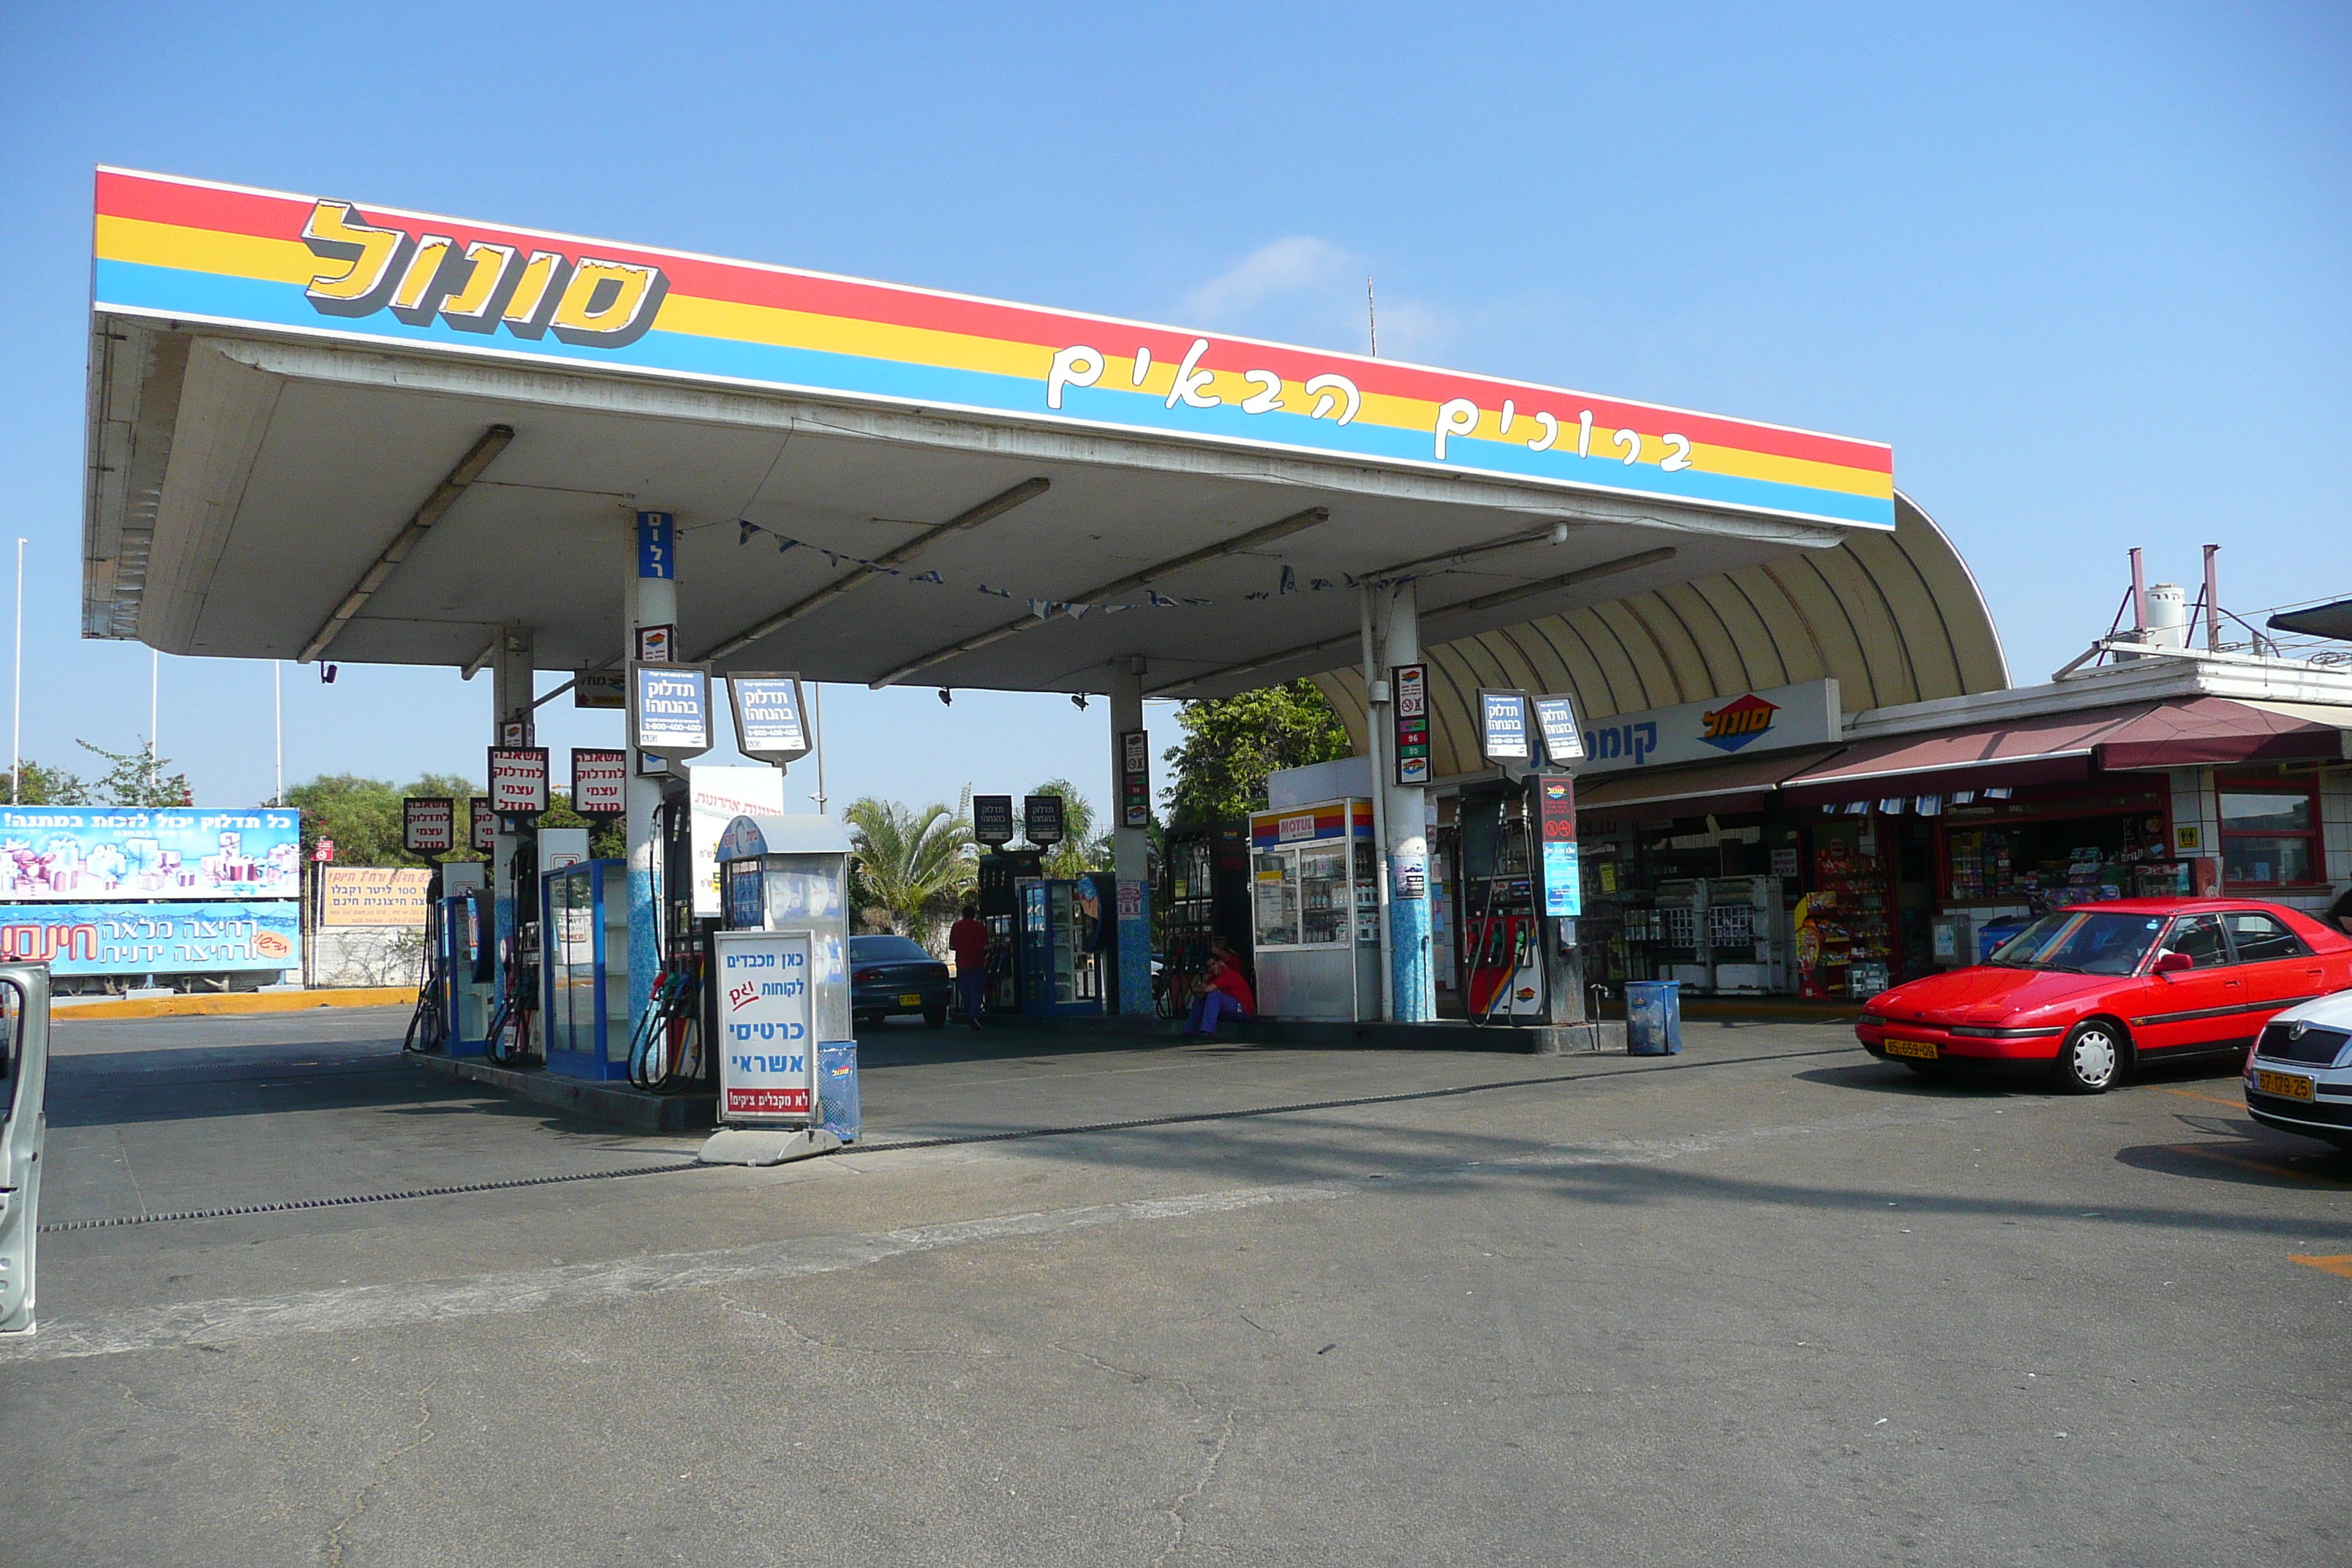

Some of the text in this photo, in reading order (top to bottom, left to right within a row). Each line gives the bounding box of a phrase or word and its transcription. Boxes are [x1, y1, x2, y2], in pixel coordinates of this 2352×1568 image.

[301, 199, 671, 349] סונול
[1047, 339, 1692, 472] ברוכים הבאים
[647, 513, 663, 577] סולר
[647, 679, 695, 698] תדלוק
[745, 689, 788, 707] תדלוק
[645, 698, 698, 714] בהנחה!
[1488, 704, 1518, 719] תדלוק
[745, 707, 794, 720] בהנחה!
[1542, 709, 1568, 724] תדלוק
[1488, 720, 1521, 731] בהנחה!
[1703, 706, 1773, 739] סונול
[494, 751, 544, 761] משאבה
[576, 753, 625, 762] משאבה
[493, 766, 544, 779] לתדלוק
[577, 769, 625, 782] לתדלוק
[502, 784, 535, 796] עצמי
[587, 786, 617, 796] עצמי
[499, 799, 536, 810] מוזל
[585, 801, 621, 811] מוזל
[694, 792, 740, 812] אחרונות
[982, 804, 1004, 815] תדלוק
[1032, 804, 1054, 815] תדלוק
[4, 813, 291, 832] כל תדלוק יכול לזכות במתנה!
[409, 813, 450, 824] לתדלוק
[1280, 818, 1313, 834] MOTUL
[414, 840, 445, 848] מוזל
[331, 884, 361, 897] וקבלו
[366, 884, 393, 894] ליטר
[333, 897, 359, 906] חינם
[363, 898, 407, 906] חיצונית
[102, 918, 258, 939] רחיצה מלאה
[1, 924, 98, 962] חינם!
[99, 943, 258, 963] ורחיצה ידנית
[727, 954, 804, 970] כאן מכבדים
[761, 978, 804, 998] לקוחות
[729, 1022, 804, 1040] כרטיסי
[732, 1055, 804, 1072] אשראי
[832, 1067, 849, 1077] סונול
[758, 1093, 791, 1109] מקבלים
[795, 1093, 808, 1106] לא
